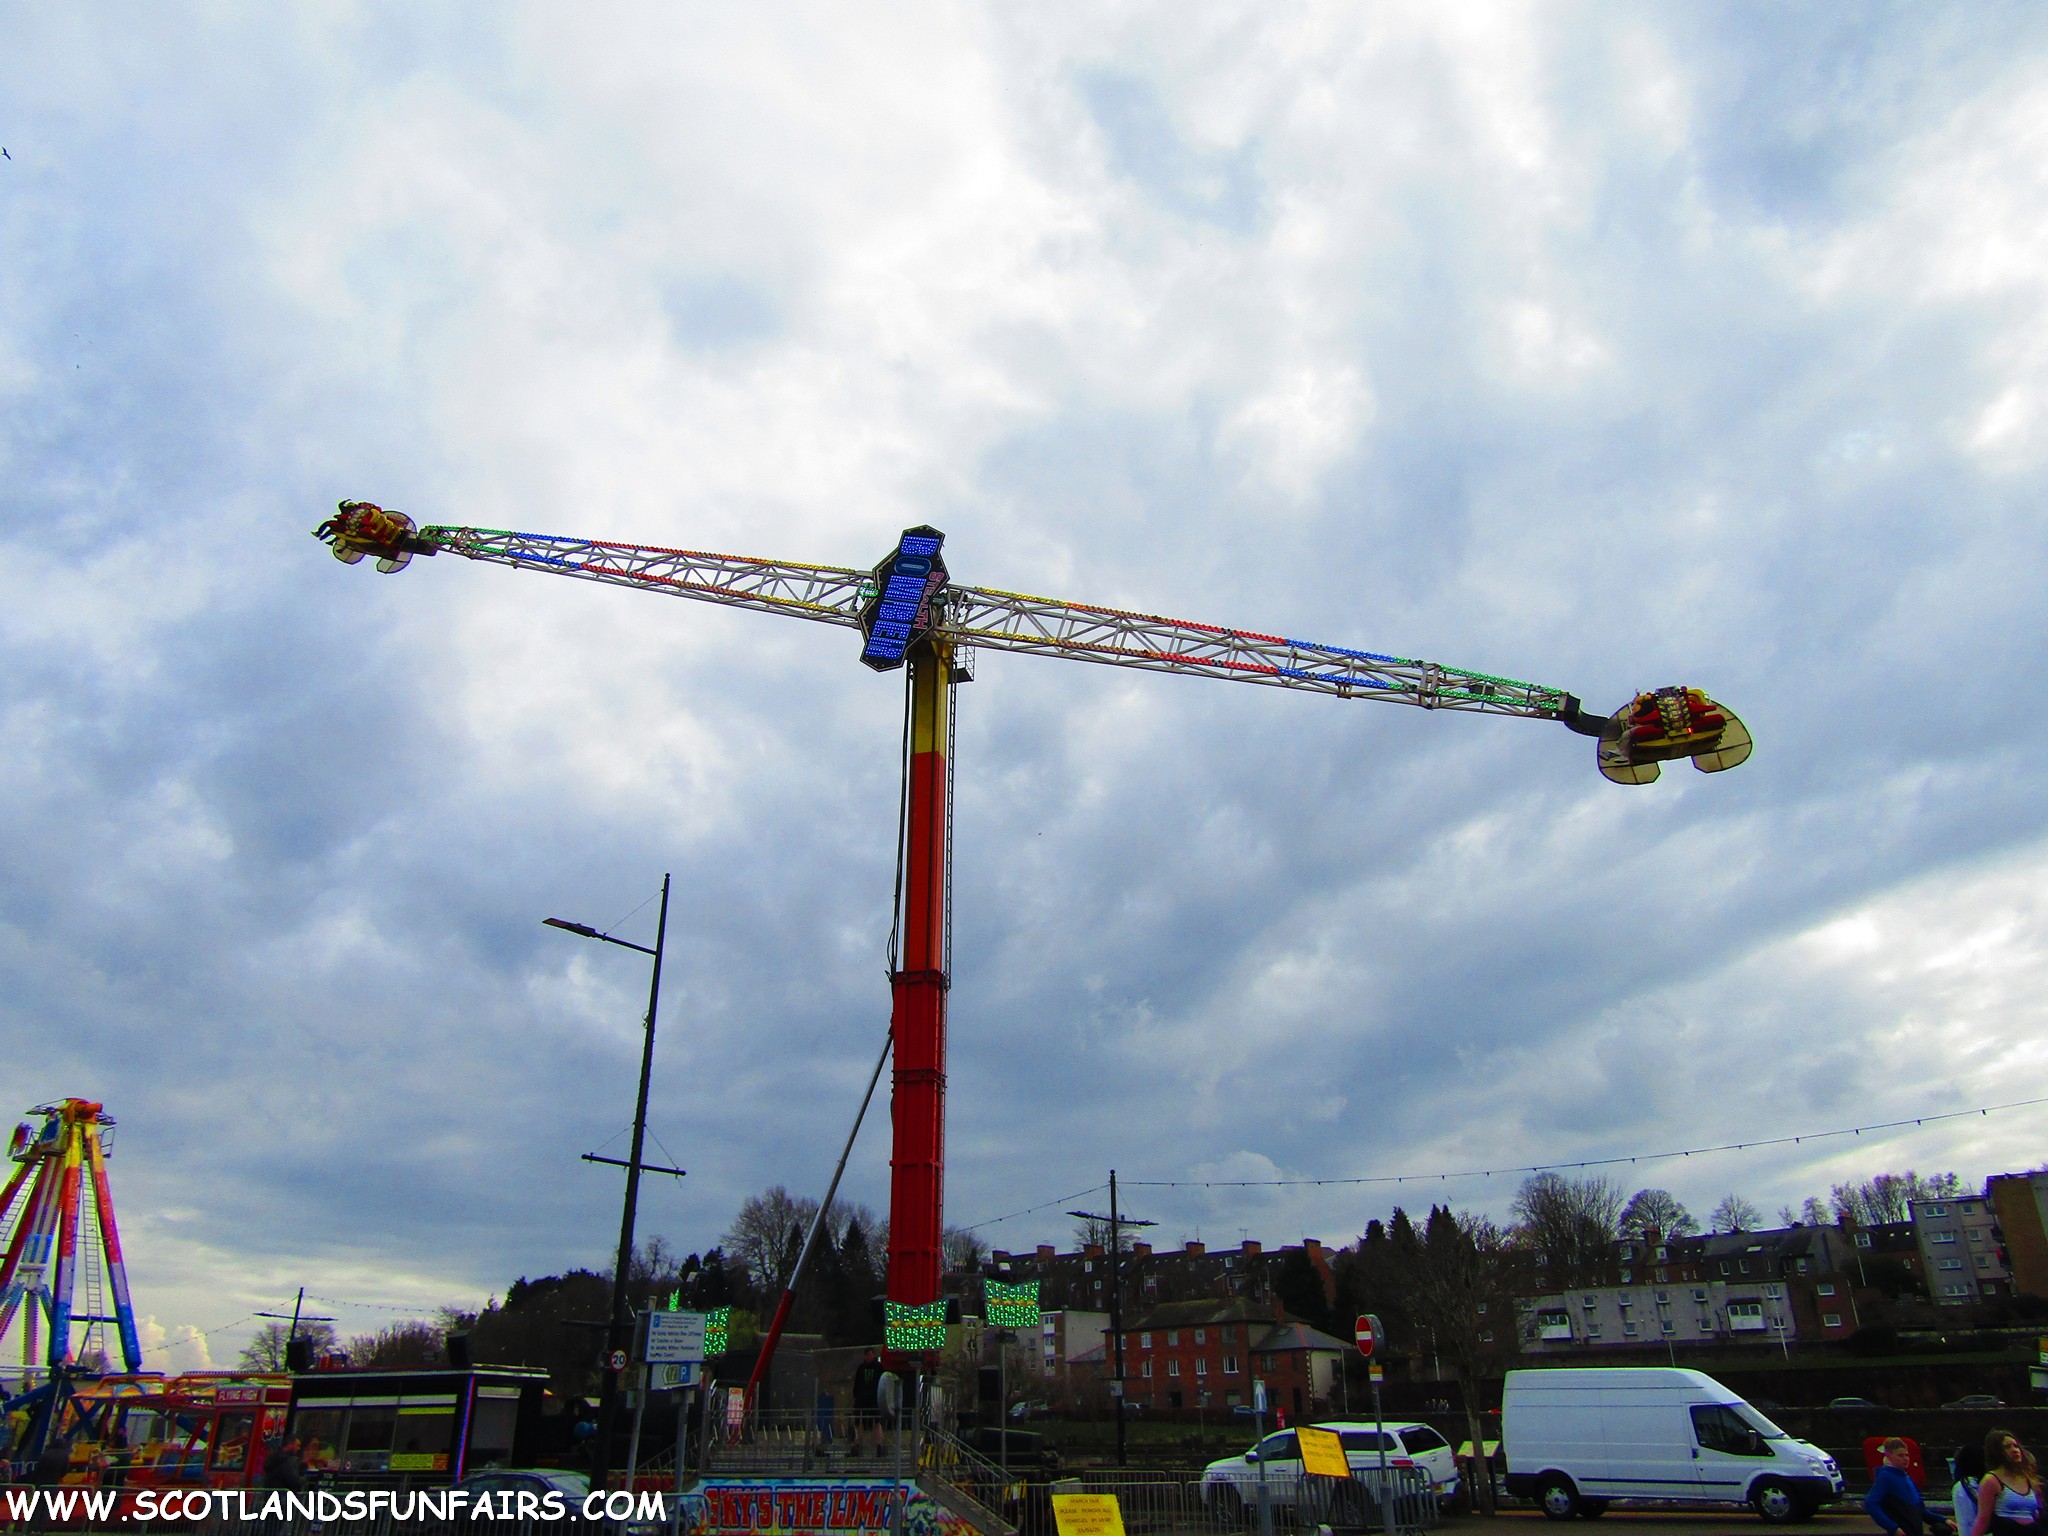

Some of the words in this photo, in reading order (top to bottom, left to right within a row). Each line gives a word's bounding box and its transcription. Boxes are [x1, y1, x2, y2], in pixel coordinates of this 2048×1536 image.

[865, 536, 939, 660] BOMBER
[913, 571, 944, 629] STEALTH
[613, 1354, 625, 1365] 20
[218, 1390, 240, 1401] FLYING
[241, 1389, 258, 1400] HIGH
[704, 1487, 773, 1528] SKY'S
[774, 1487, 828, 1528] THE
[827, 1486, 909, 1529] LIMIT
